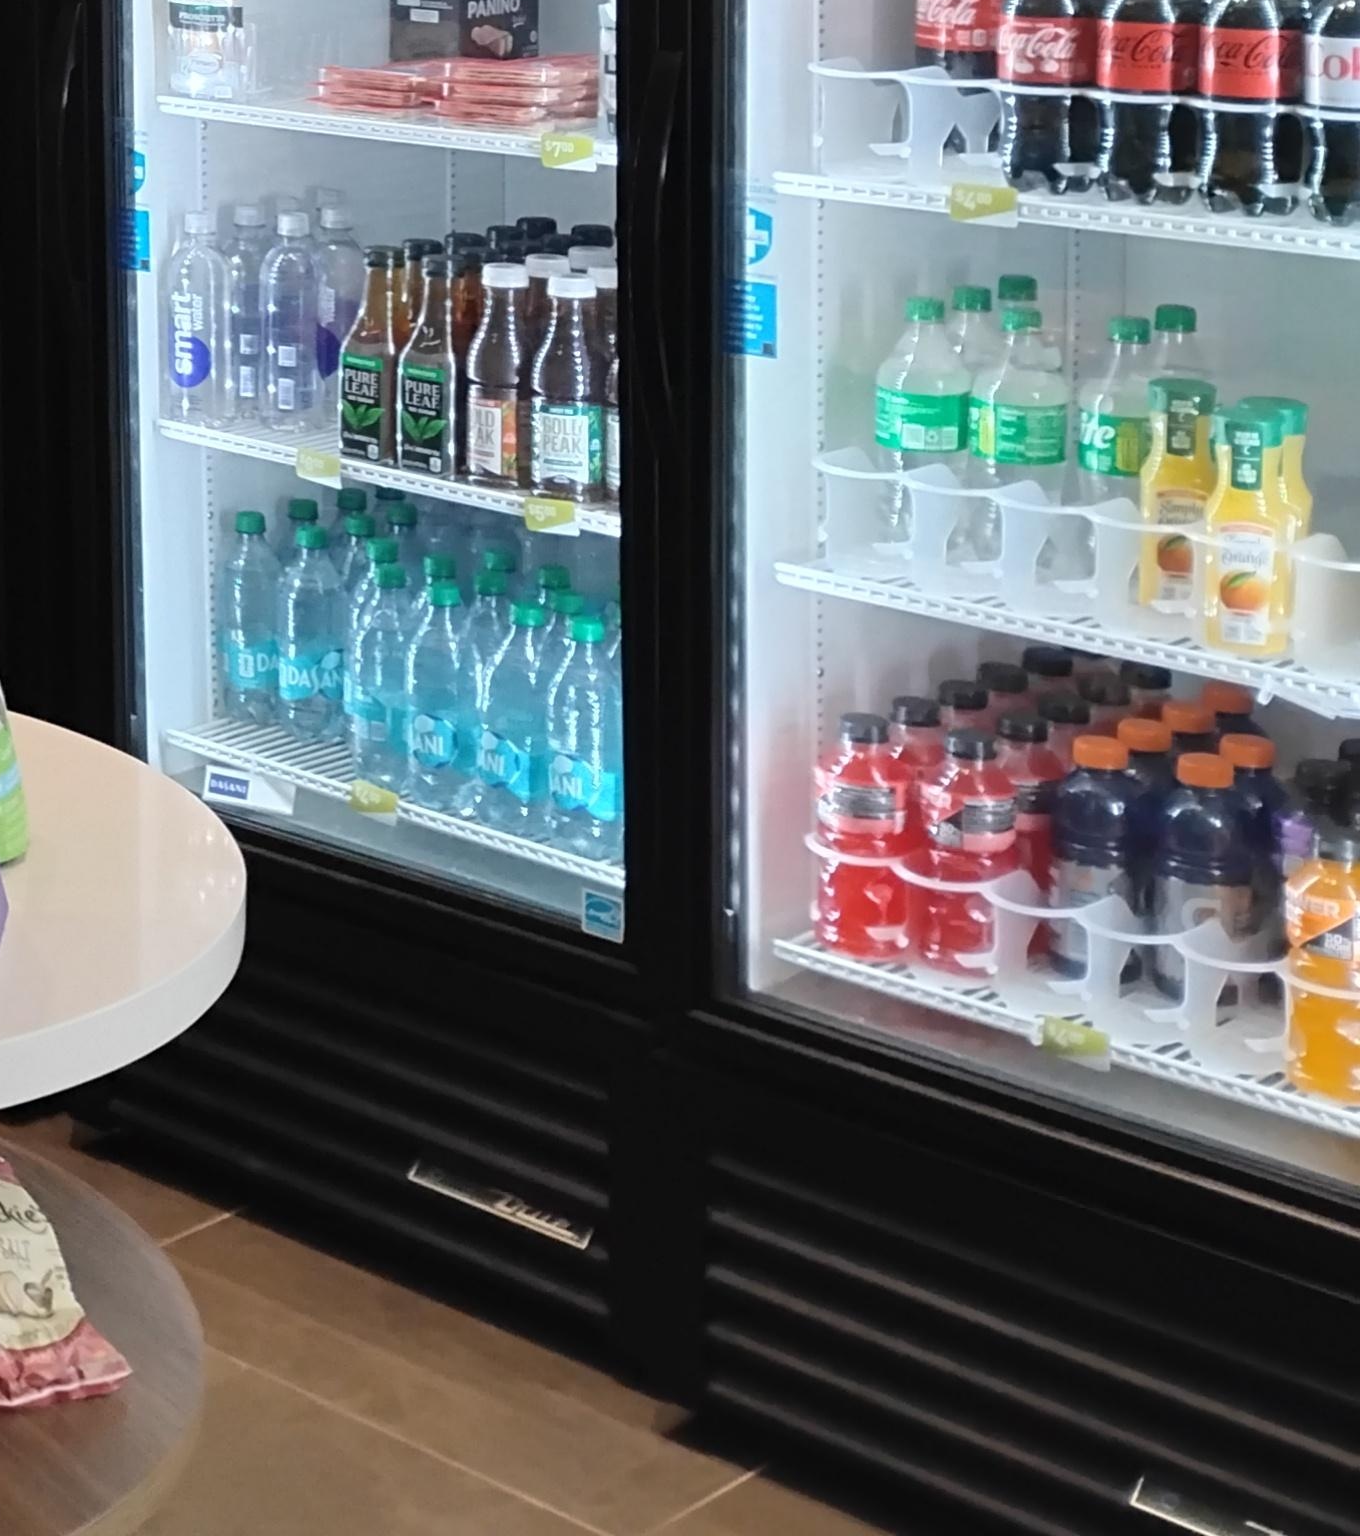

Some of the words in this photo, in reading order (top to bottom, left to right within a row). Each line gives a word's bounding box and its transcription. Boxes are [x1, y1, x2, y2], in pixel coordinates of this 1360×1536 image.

[192, 294, 203, 330] water
[174, 289, 194, 375] smart
[344, 367, 379, 386] PURE
[405, 379, 440, 396] PURE
[543, 434, 581, 454] PEAK
[209, 777, 248, 795] DASANI
